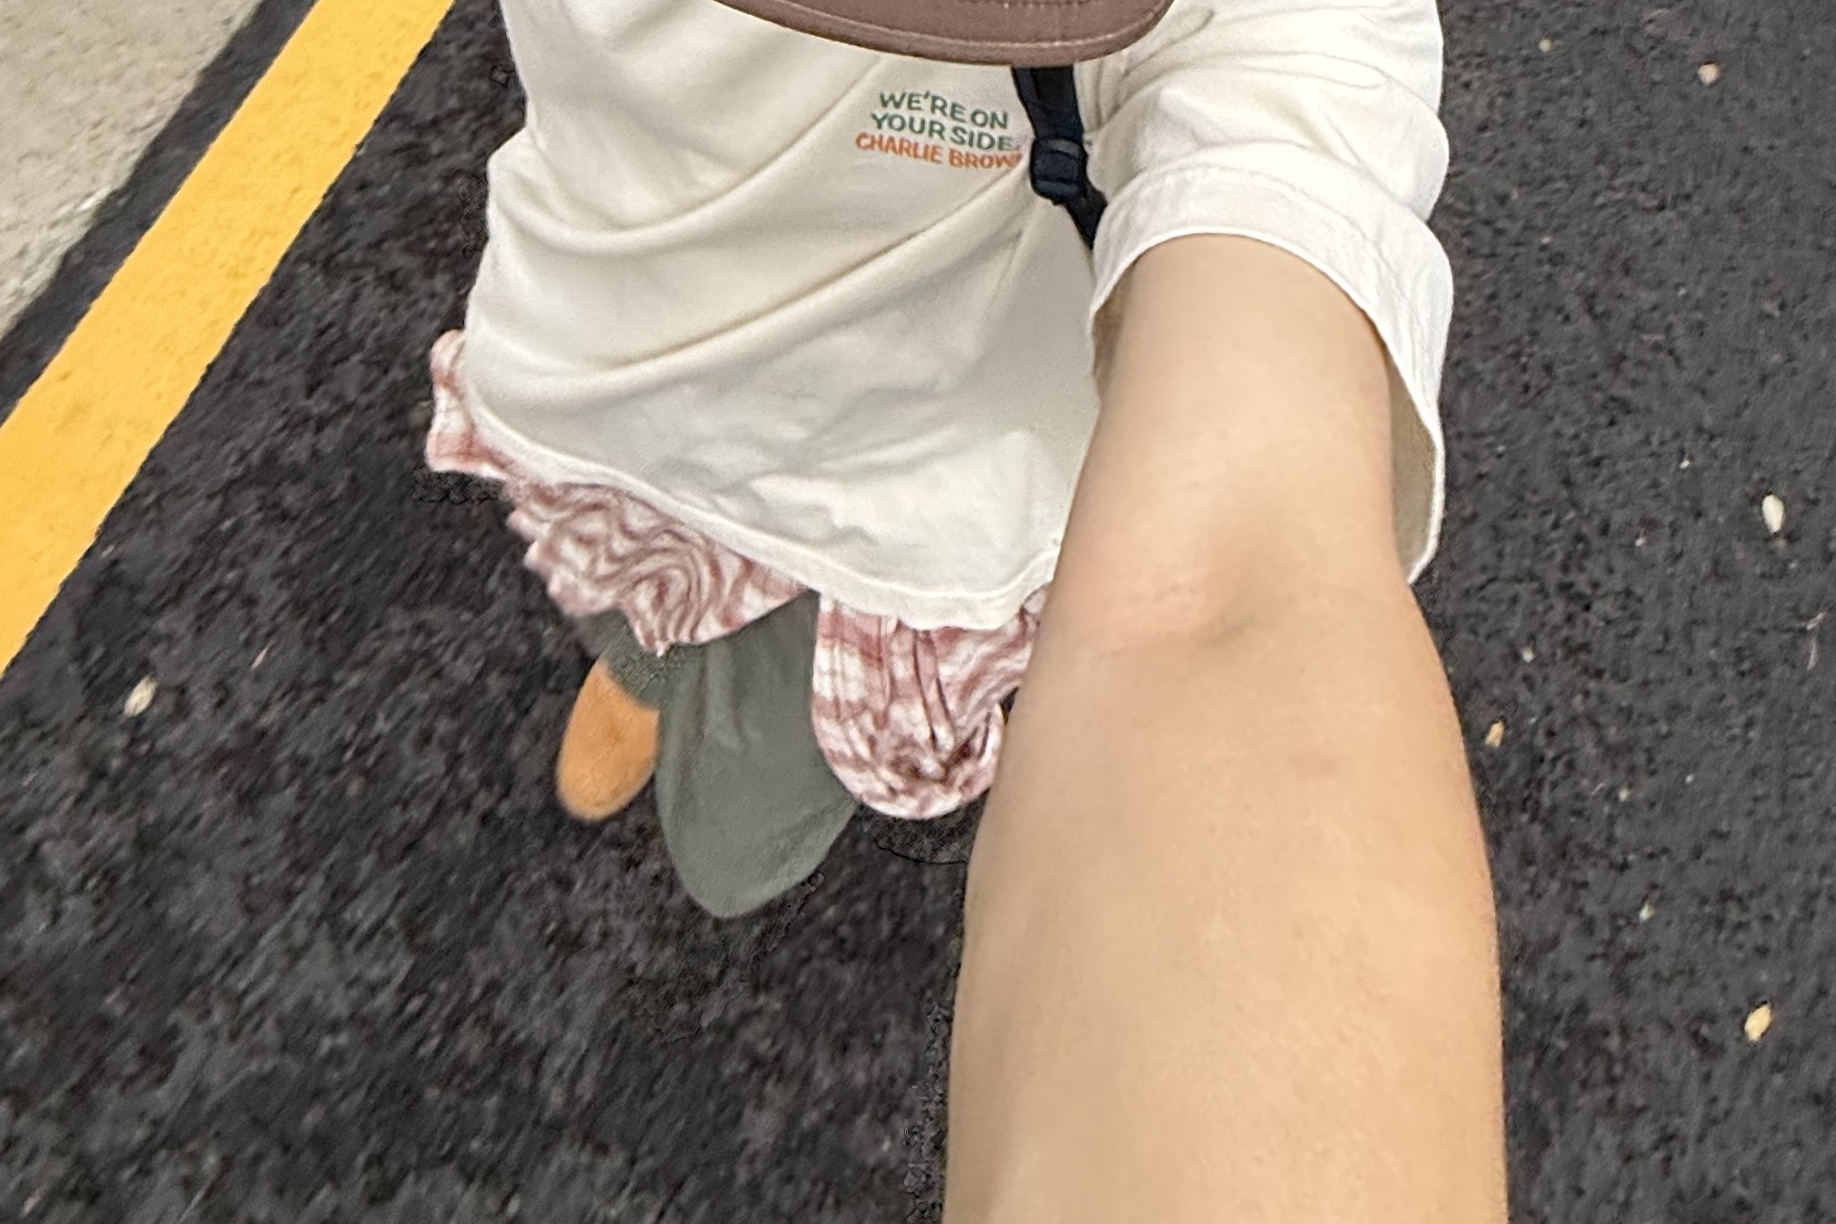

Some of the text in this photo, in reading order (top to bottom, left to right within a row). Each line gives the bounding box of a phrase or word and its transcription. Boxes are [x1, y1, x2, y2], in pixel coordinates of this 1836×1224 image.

[871, 112, 945, 140] YOUR
[880, 91, 1008, 129] WE'RE ON
[855, 132, 1022, 169] CHARLIE BROW
